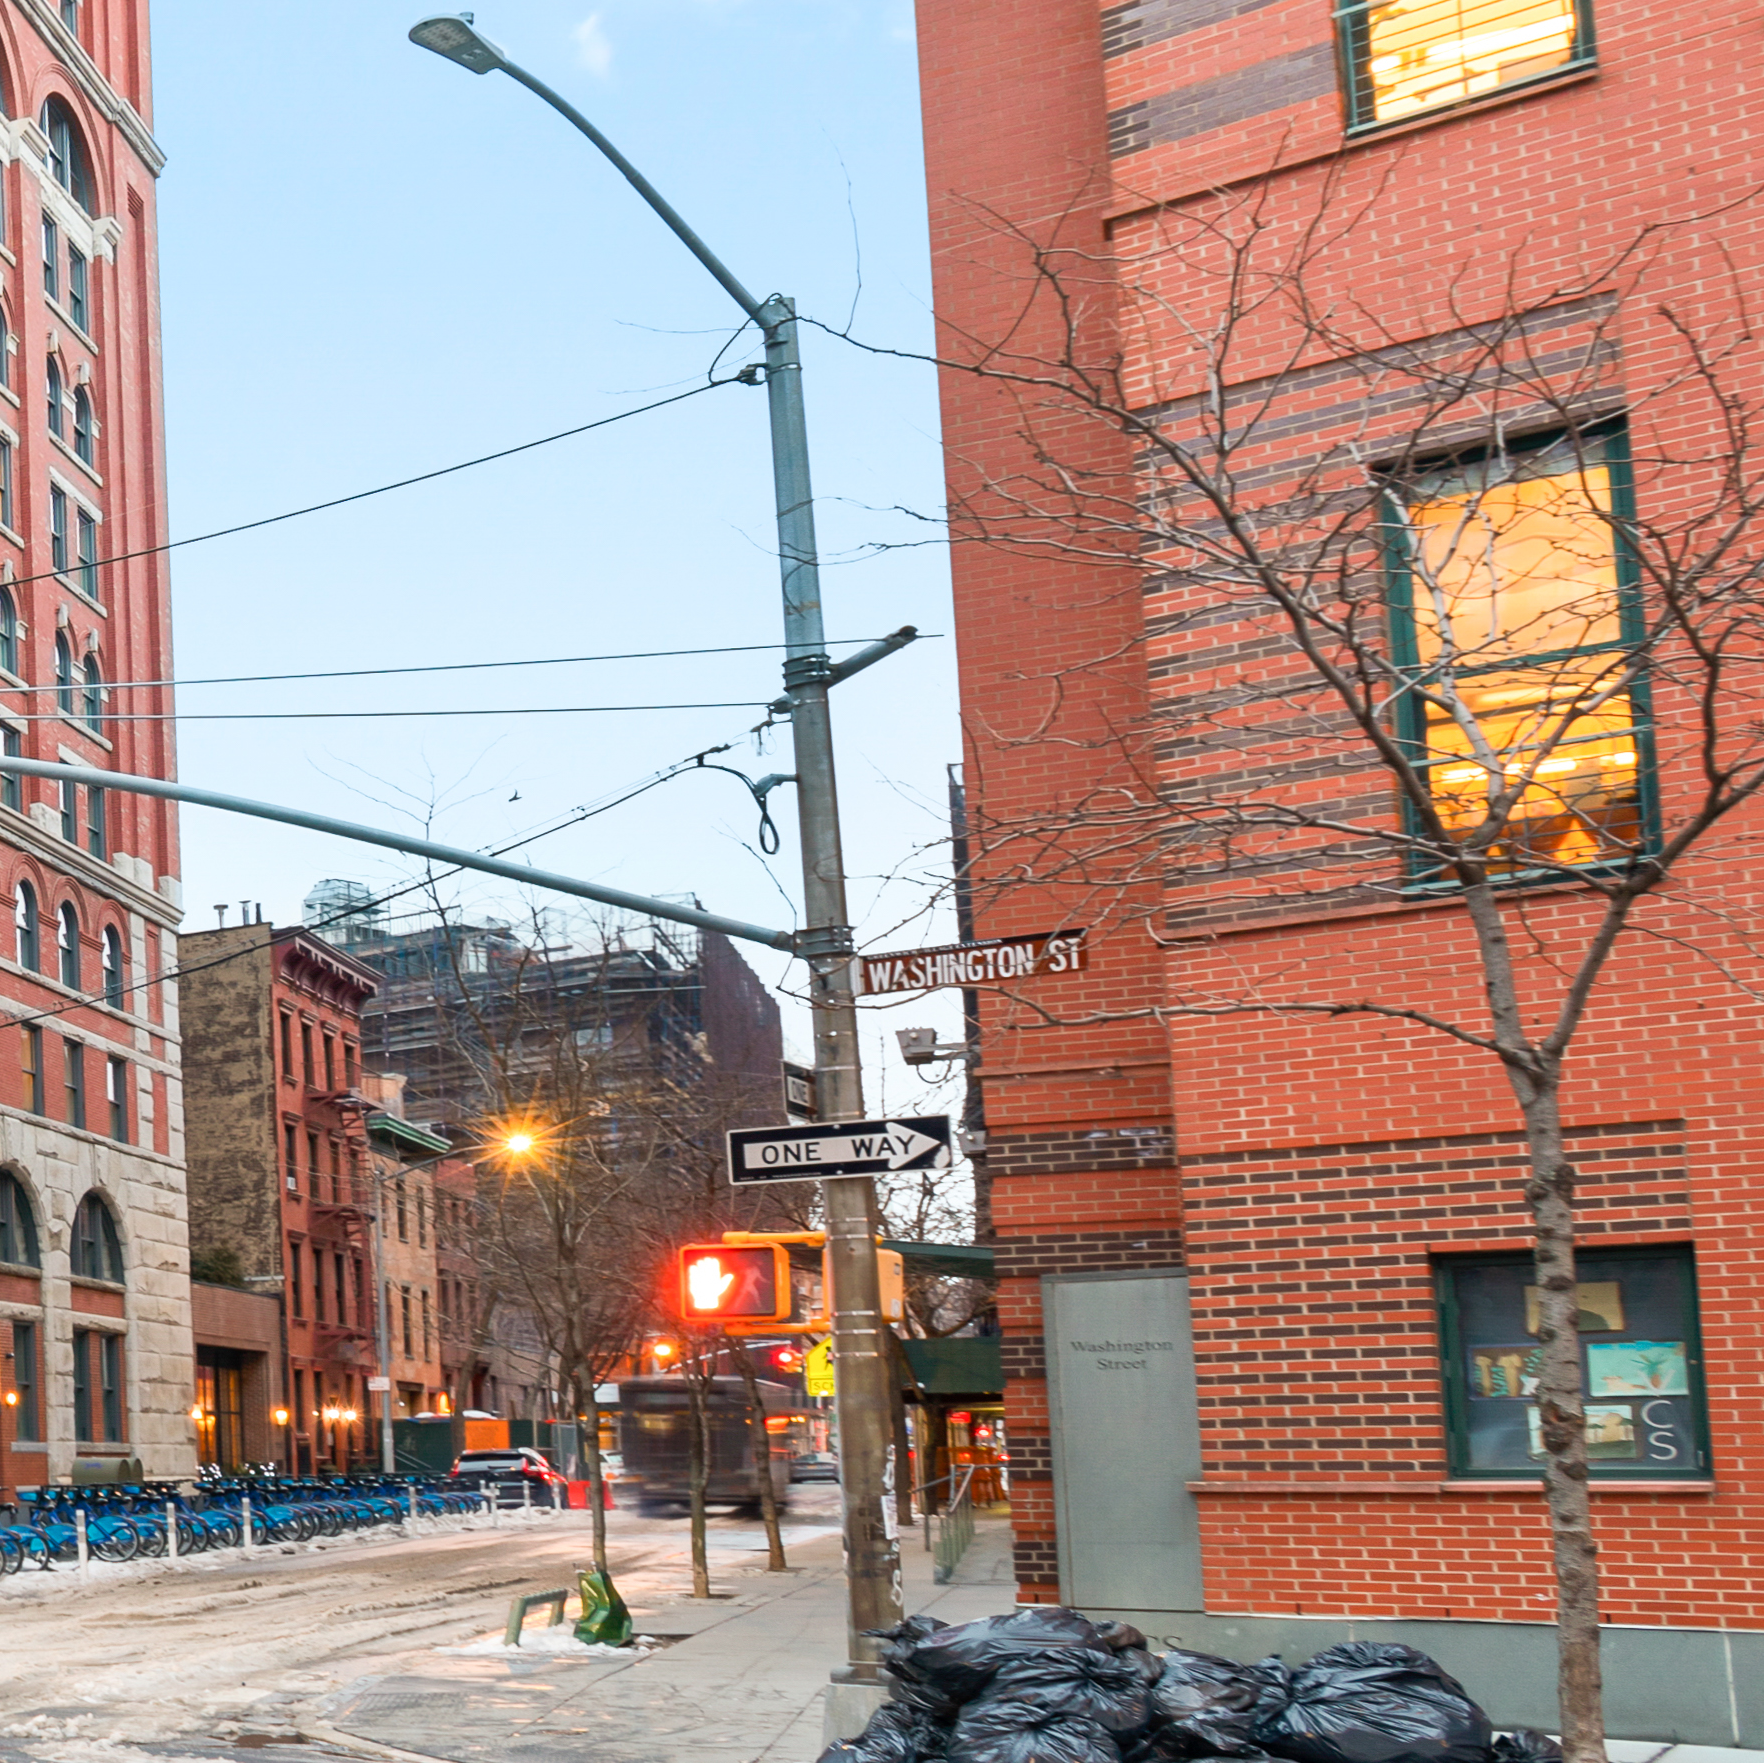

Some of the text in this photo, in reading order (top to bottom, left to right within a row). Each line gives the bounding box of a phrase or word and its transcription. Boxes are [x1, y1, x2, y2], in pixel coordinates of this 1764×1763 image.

[869, 938, 1081, 993] WASHINGTON ST
[791, 1080, 808, 1103] ONE
[762, 1134, 916, 1164] ONE WAY
[1070, 1340, 1173, 1354] Washington
[1097, 1358, 1147, 1370] Street
